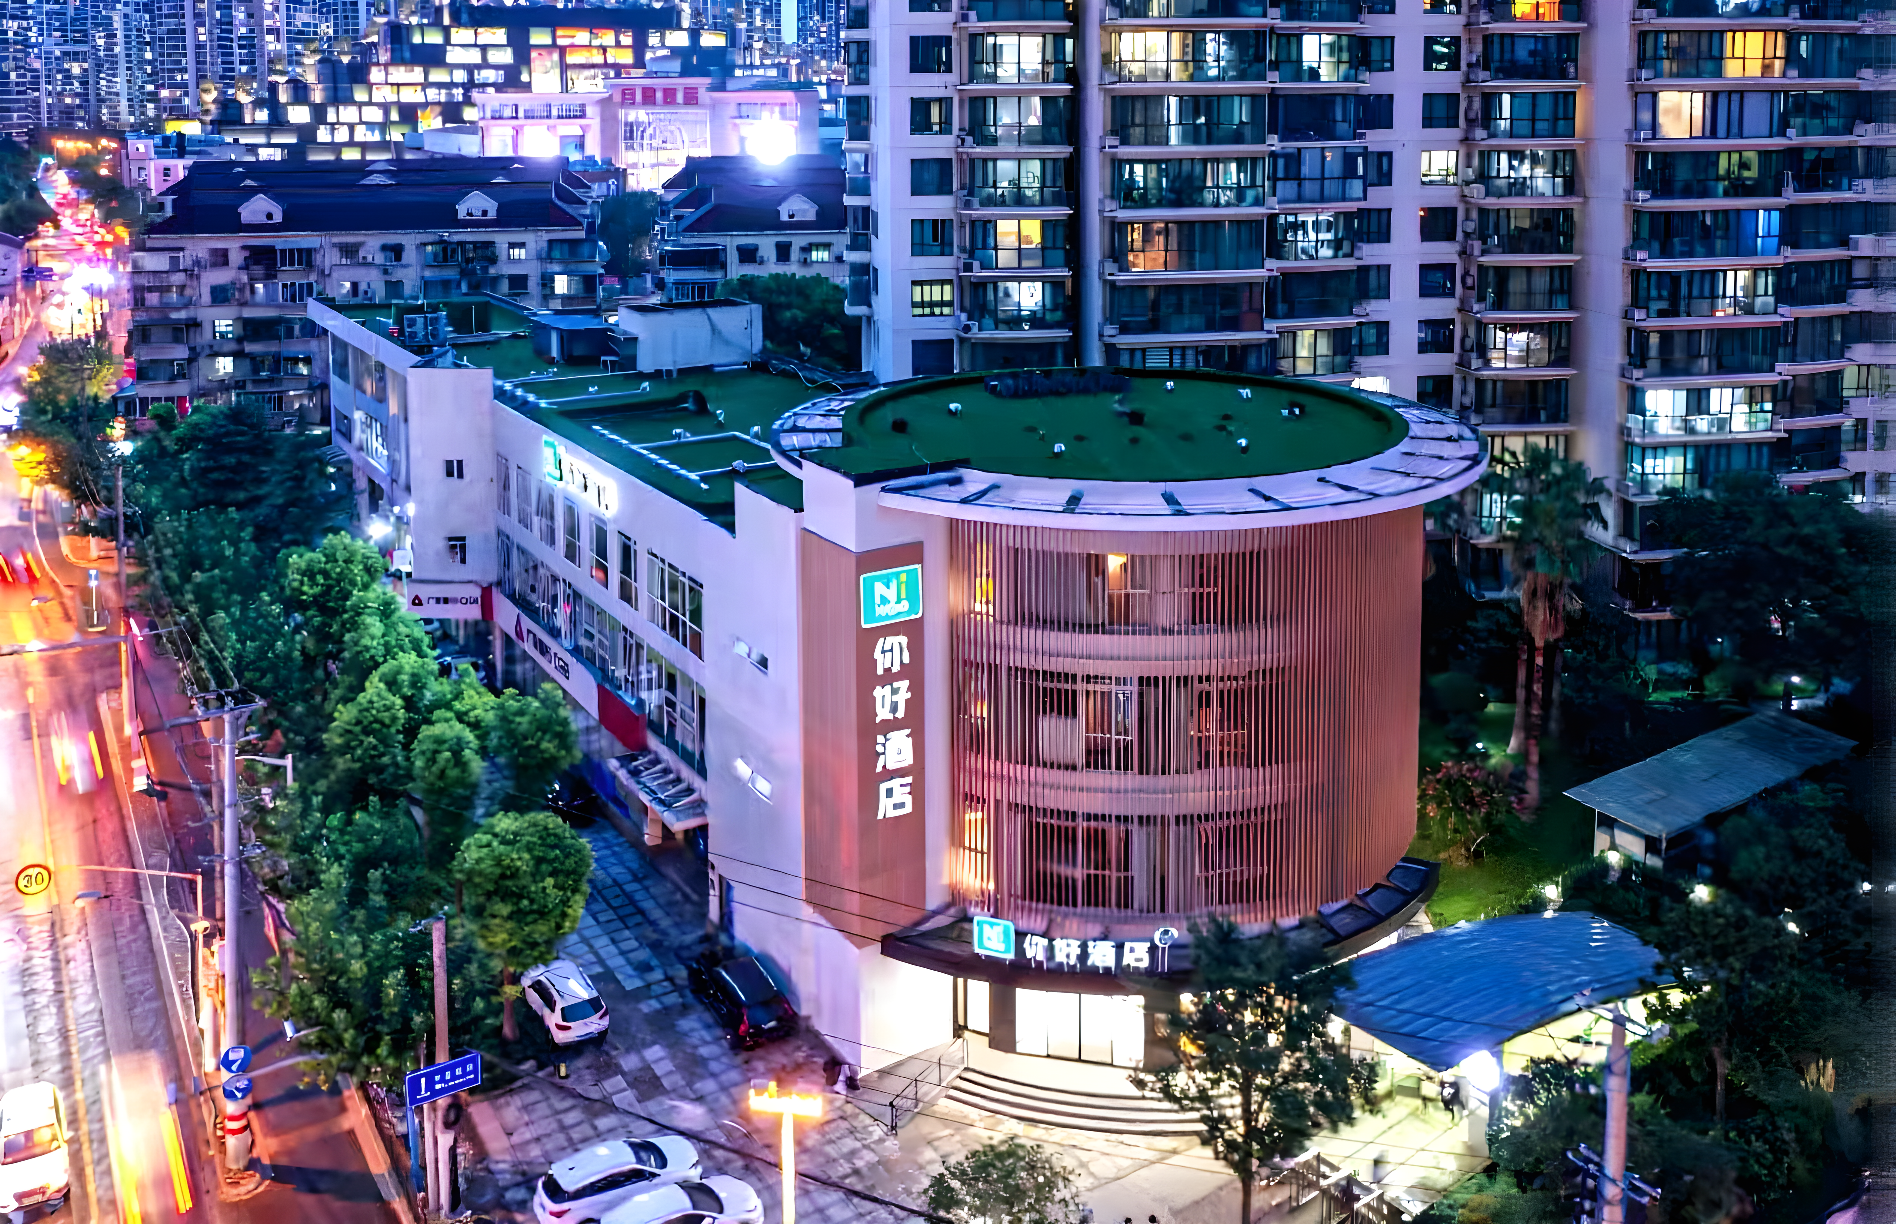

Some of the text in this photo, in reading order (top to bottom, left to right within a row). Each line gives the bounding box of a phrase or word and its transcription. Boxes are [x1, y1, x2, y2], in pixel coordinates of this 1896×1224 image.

[873, 634, 914, 820] 你好酒店
[1023, 933, 1151, 968] 你好酒店
